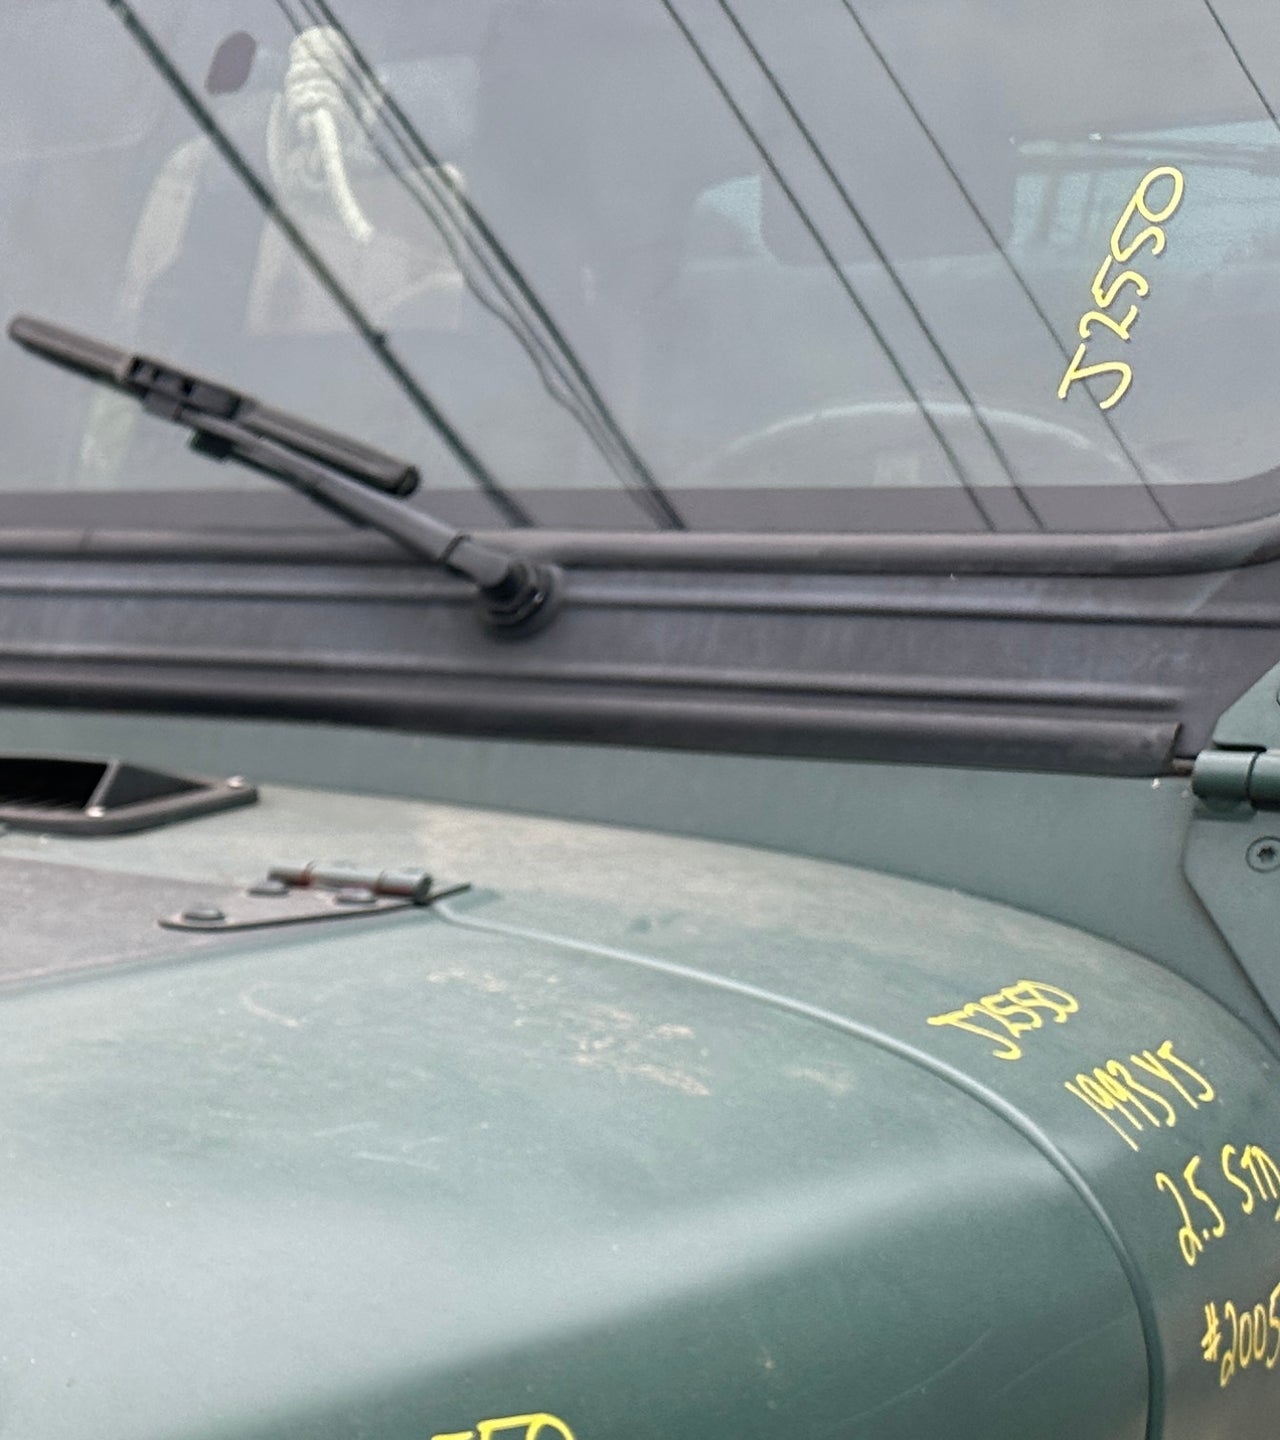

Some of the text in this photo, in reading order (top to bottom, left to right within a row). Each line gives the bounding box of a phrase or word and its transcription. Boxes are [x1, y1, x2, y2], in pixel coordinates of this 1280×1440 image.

[1056, 164, 1186, 410] J2550
[926, 978, 1081, 1061] J2550
[1063, 1057, 1178, 1152] 1993
[1153, 1154, 1228, 1267] 2.5
